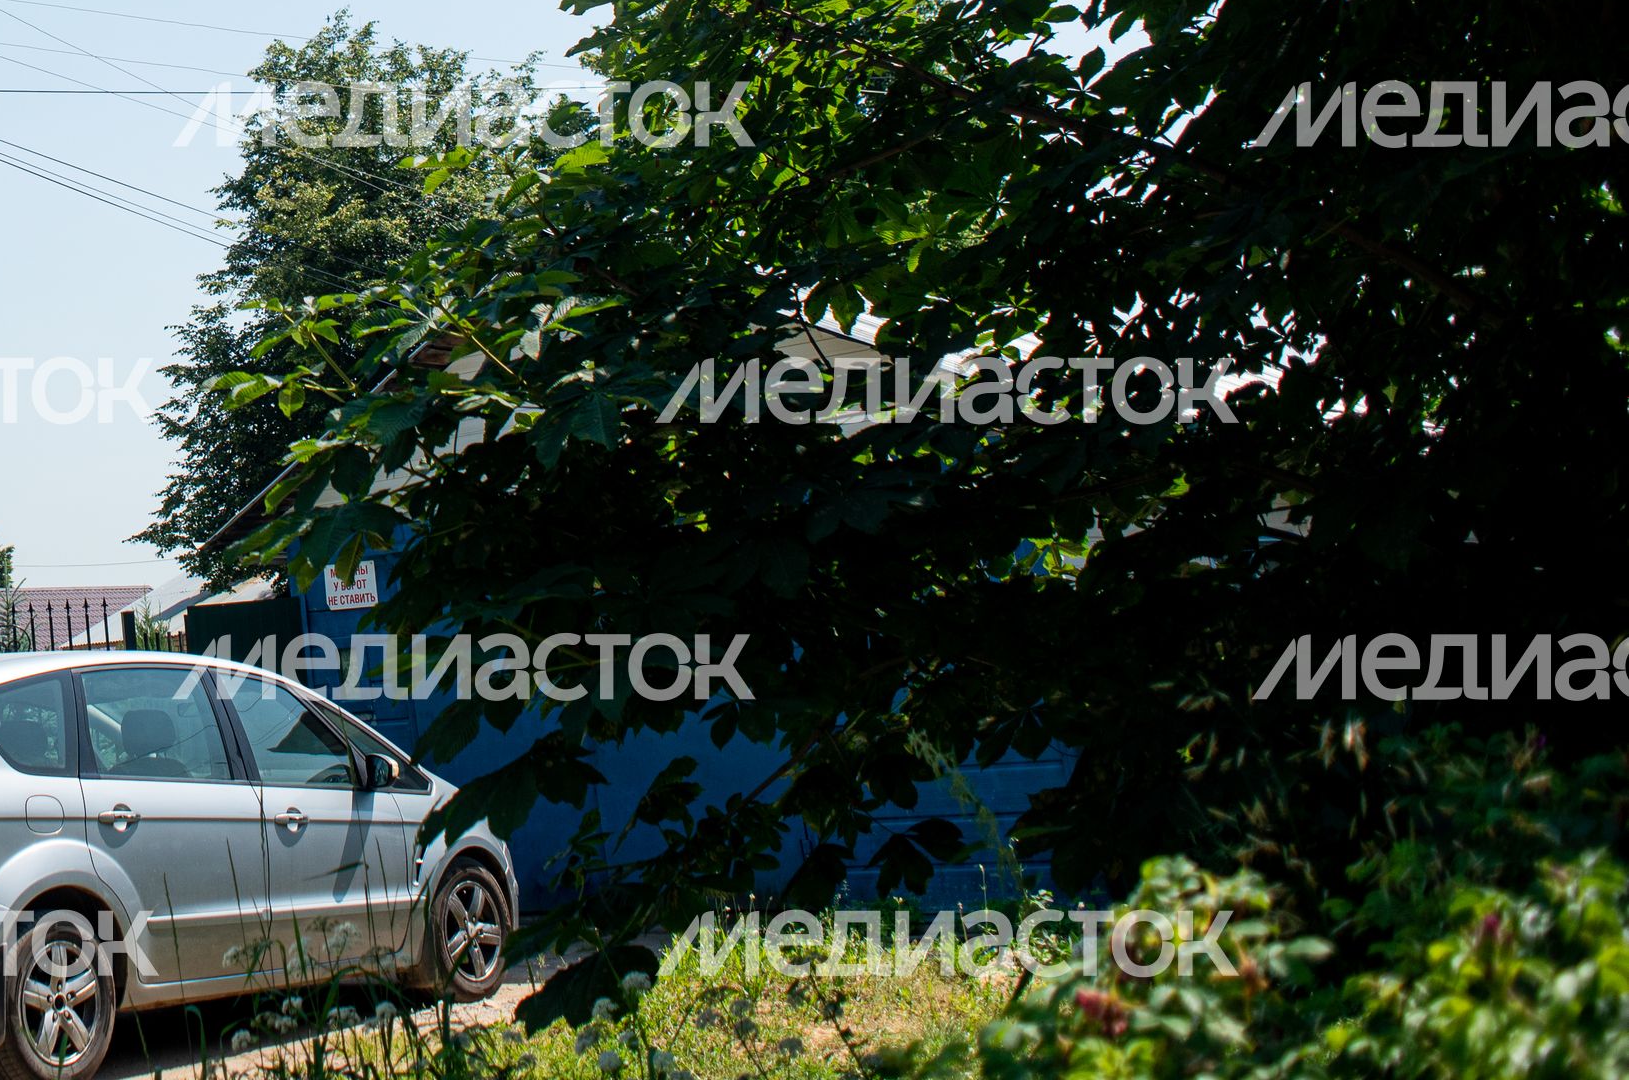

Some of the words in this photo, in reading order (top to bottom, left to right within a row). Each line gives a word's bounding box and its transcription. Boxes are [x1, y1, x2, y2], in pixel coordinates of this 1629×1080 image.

[331, 566, 368, 578] МНЫ
[333, 581, 339, 592] У
[328, 595, 338, 606] НЕ
[340, 593, 375, 604] СТАВИТЬ
